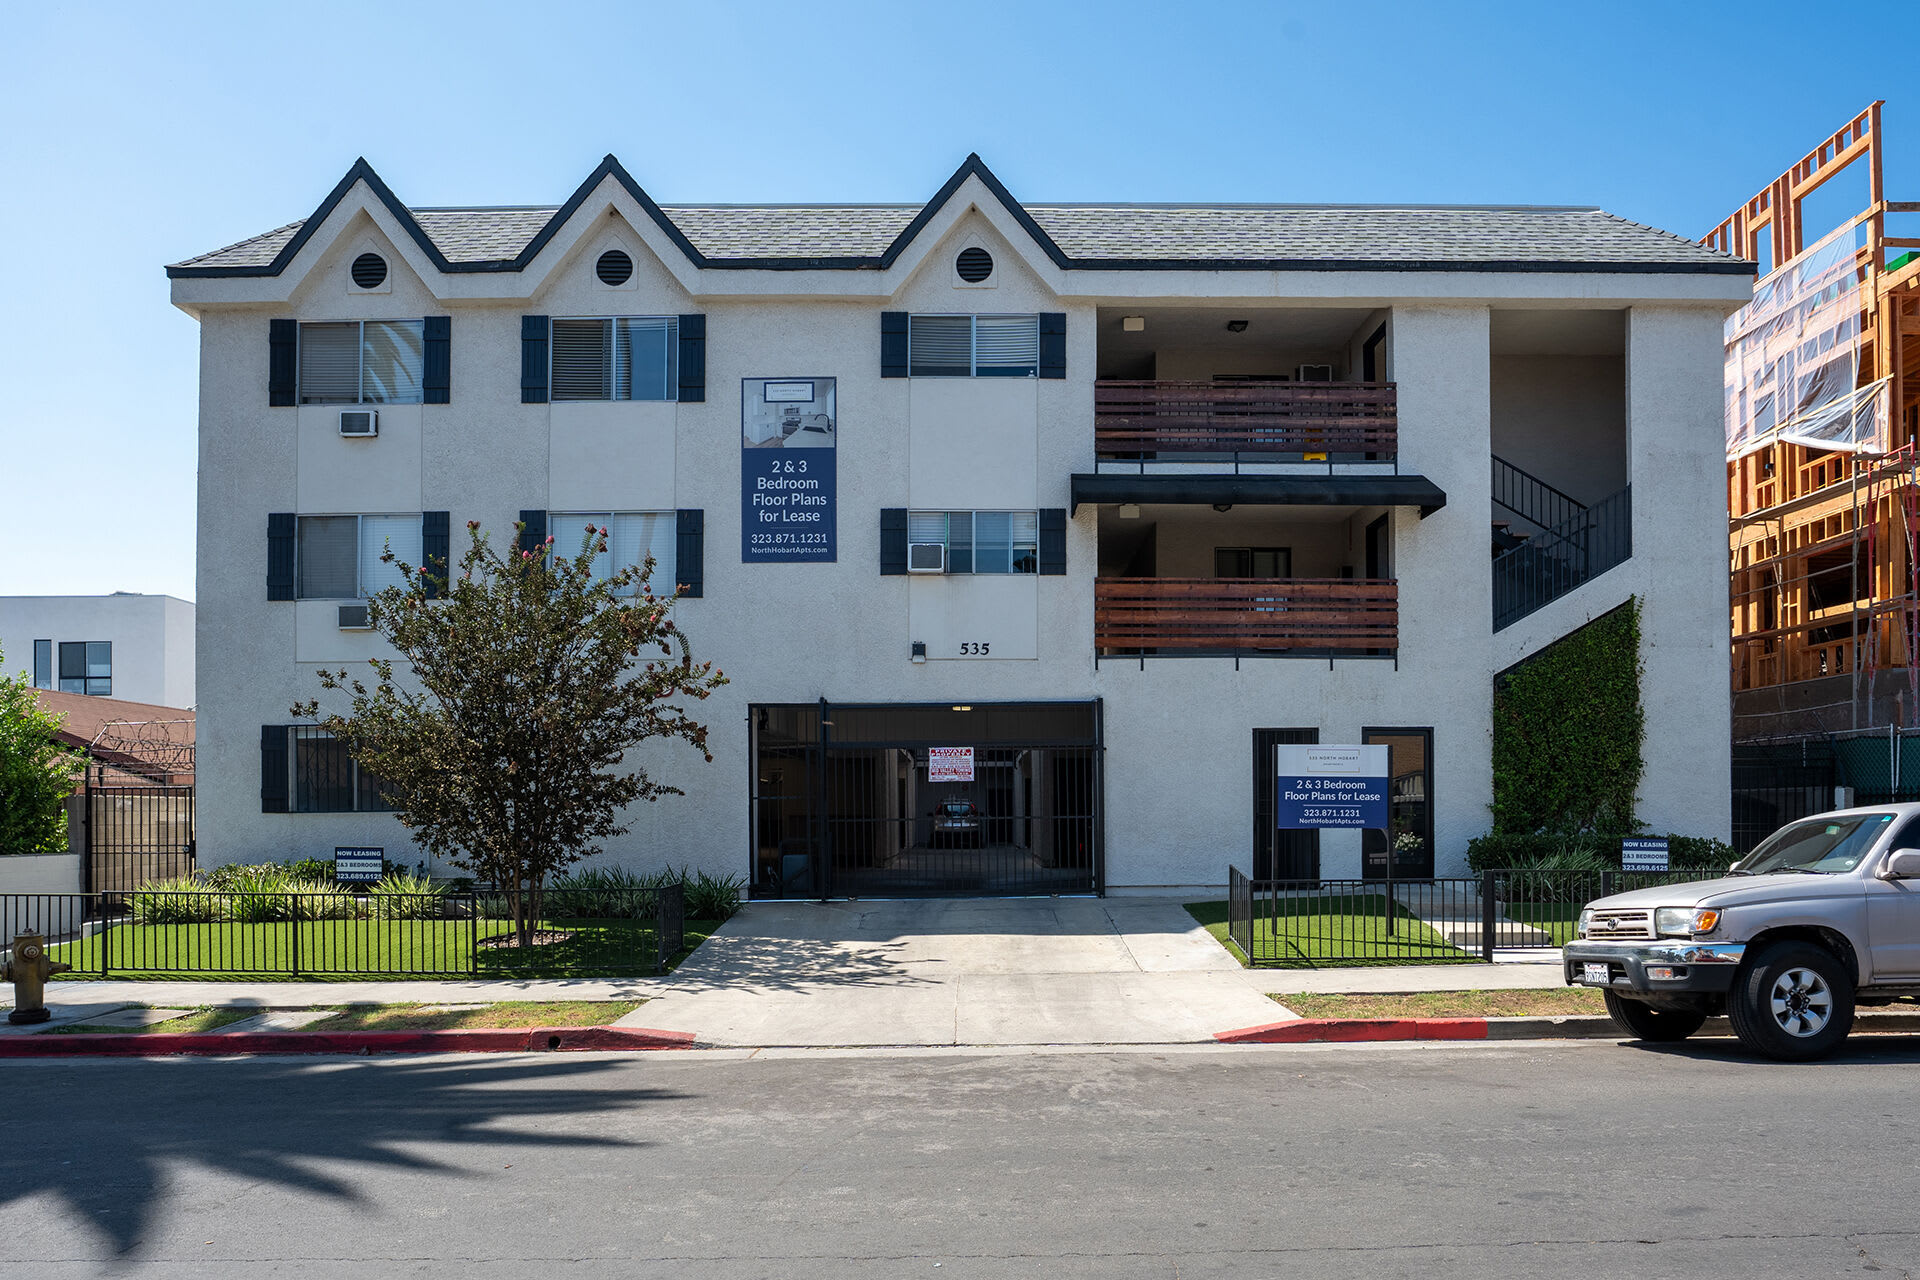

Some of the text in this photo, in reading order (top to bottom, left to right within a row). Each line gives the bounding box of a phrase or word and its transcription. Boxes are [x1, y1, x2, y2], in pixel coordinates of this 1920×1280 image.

[772, 460, 807, 473] 2 & 3
[757, 477, 818, 490] Bedroom
[753, 493, 827, 506] Floor Plans
[759, 509, 820, 522] for Lease
[751, 533, 828, 544] 323.871.1231
[960, 642, 990, 655] 535
[1296, 780, 1366, 789] 2 & 3 Bedroom
[1284, 791, 1380, 801] Floor Plans for Lease
[1304, 809, 1360, 817] 323.871.1231
